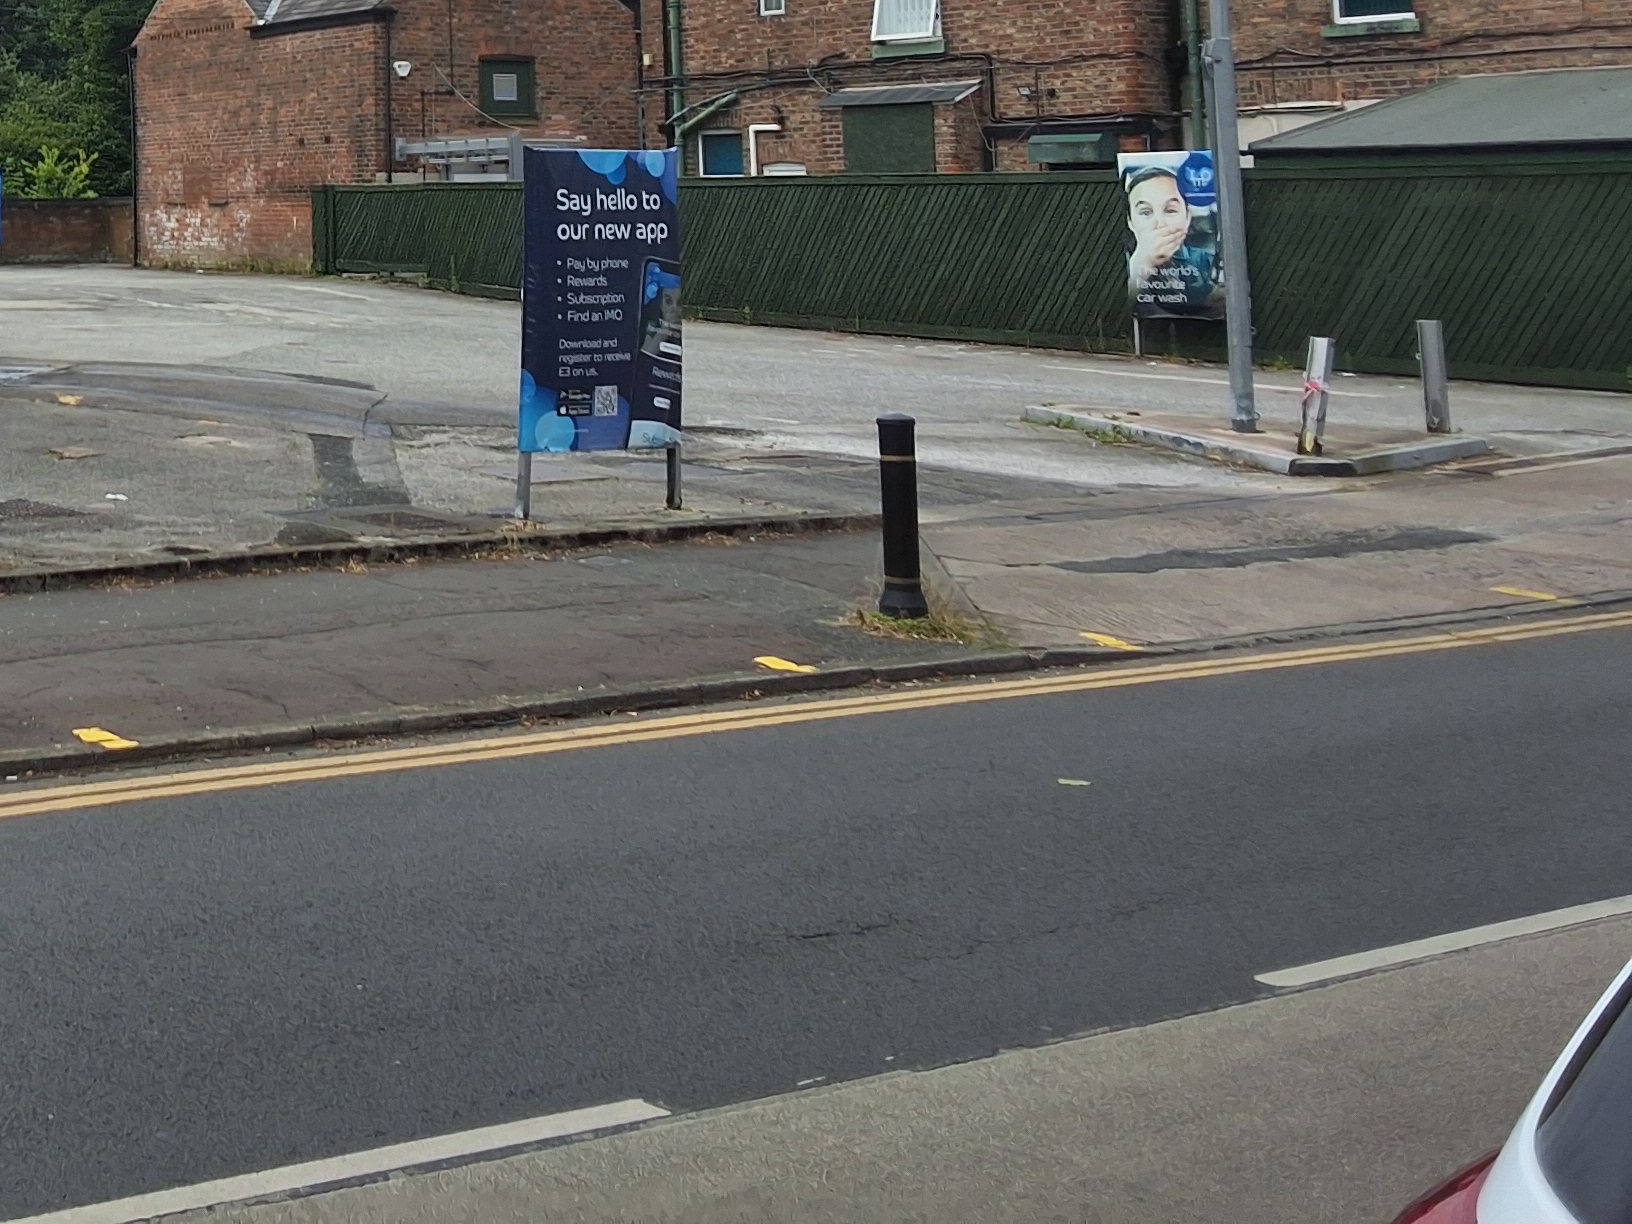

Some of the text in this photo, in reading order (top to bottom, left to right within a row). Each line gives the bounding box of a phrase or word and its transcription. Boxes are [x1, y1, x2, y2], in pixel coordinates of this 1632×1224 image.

[556, 187, 661, 216] Say hello to
[556, 222, 668, 244] our new app
[567, 256, 629, 272] Pay by phone
[567, 274, 608, 287] Rewards
[1136, 278, 1186, 290] favourite
[567, 292, 625, 306] Subscription
[1136, 293, 1188, 303] car wash
[567, 308, 623, 322] Find an IMO
[559, 337, 618, 349] Download and
[593, 353, 603, 362] to
[572, 368, 584, 377] on
